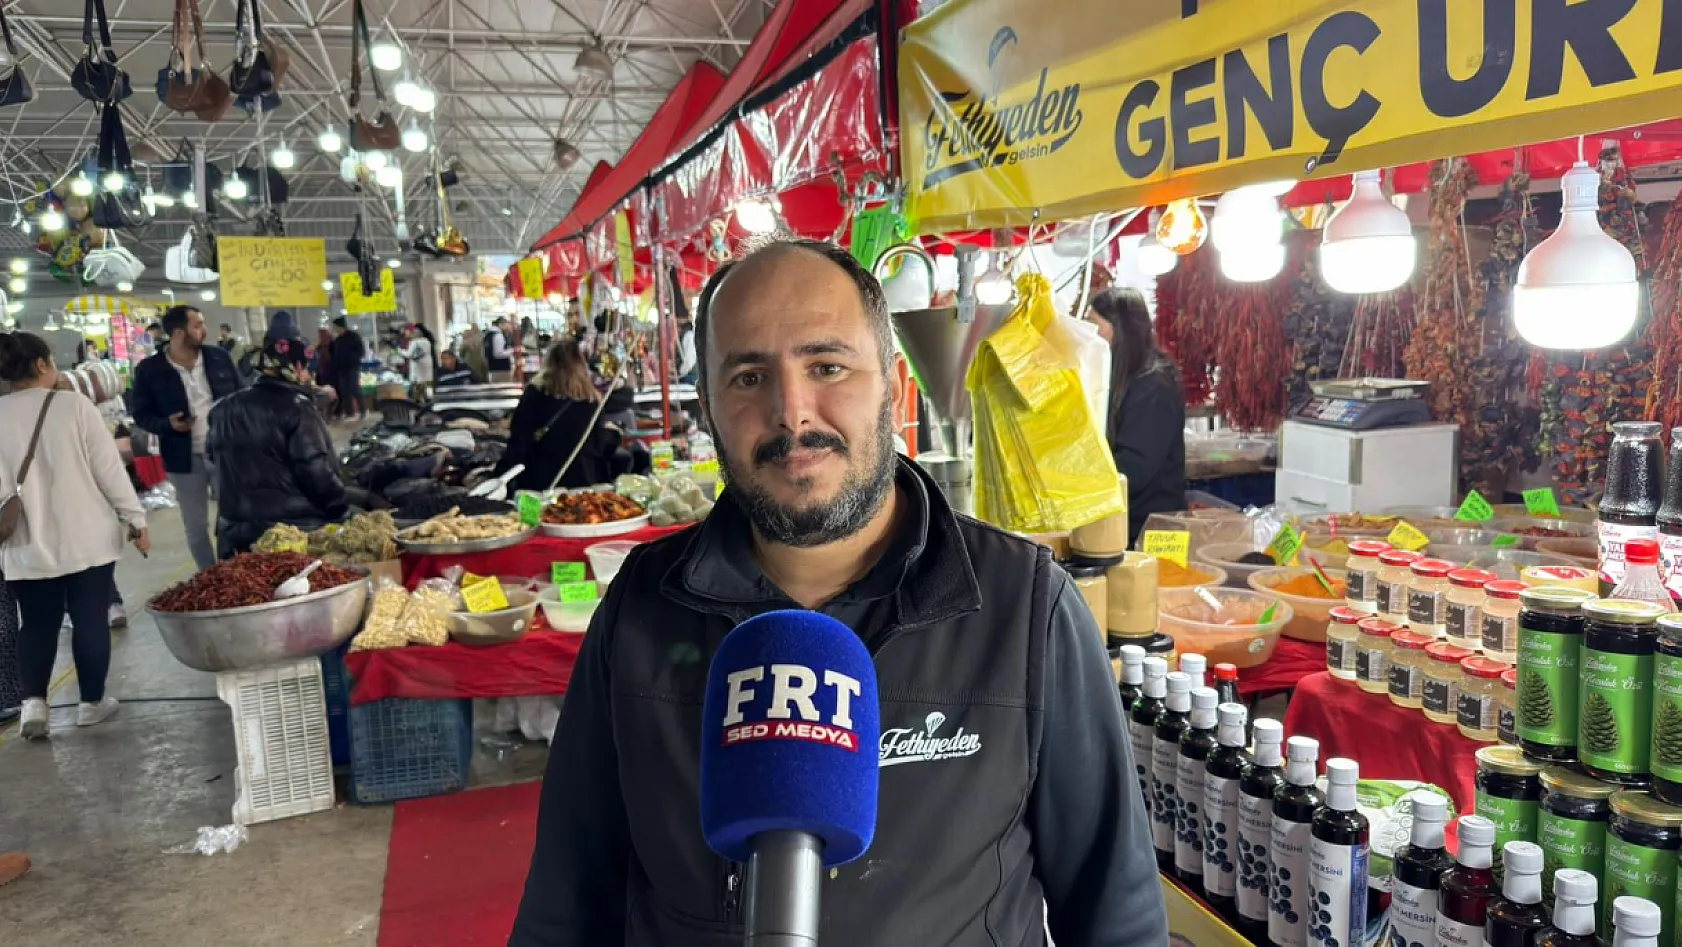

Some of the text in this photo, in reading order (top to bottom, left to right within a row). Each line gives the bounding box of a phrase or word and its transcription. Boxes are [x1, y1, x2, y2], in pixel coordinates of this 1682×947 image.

[1115, 10, 1382, 179] GENÇ
[1007, 143, 1049, 165] gelsin
[723, 663, 861, 731] FRT
[727, 722, 853, 749] SED MEDYA
[880, 727, 982, 759] Fethiyeden
